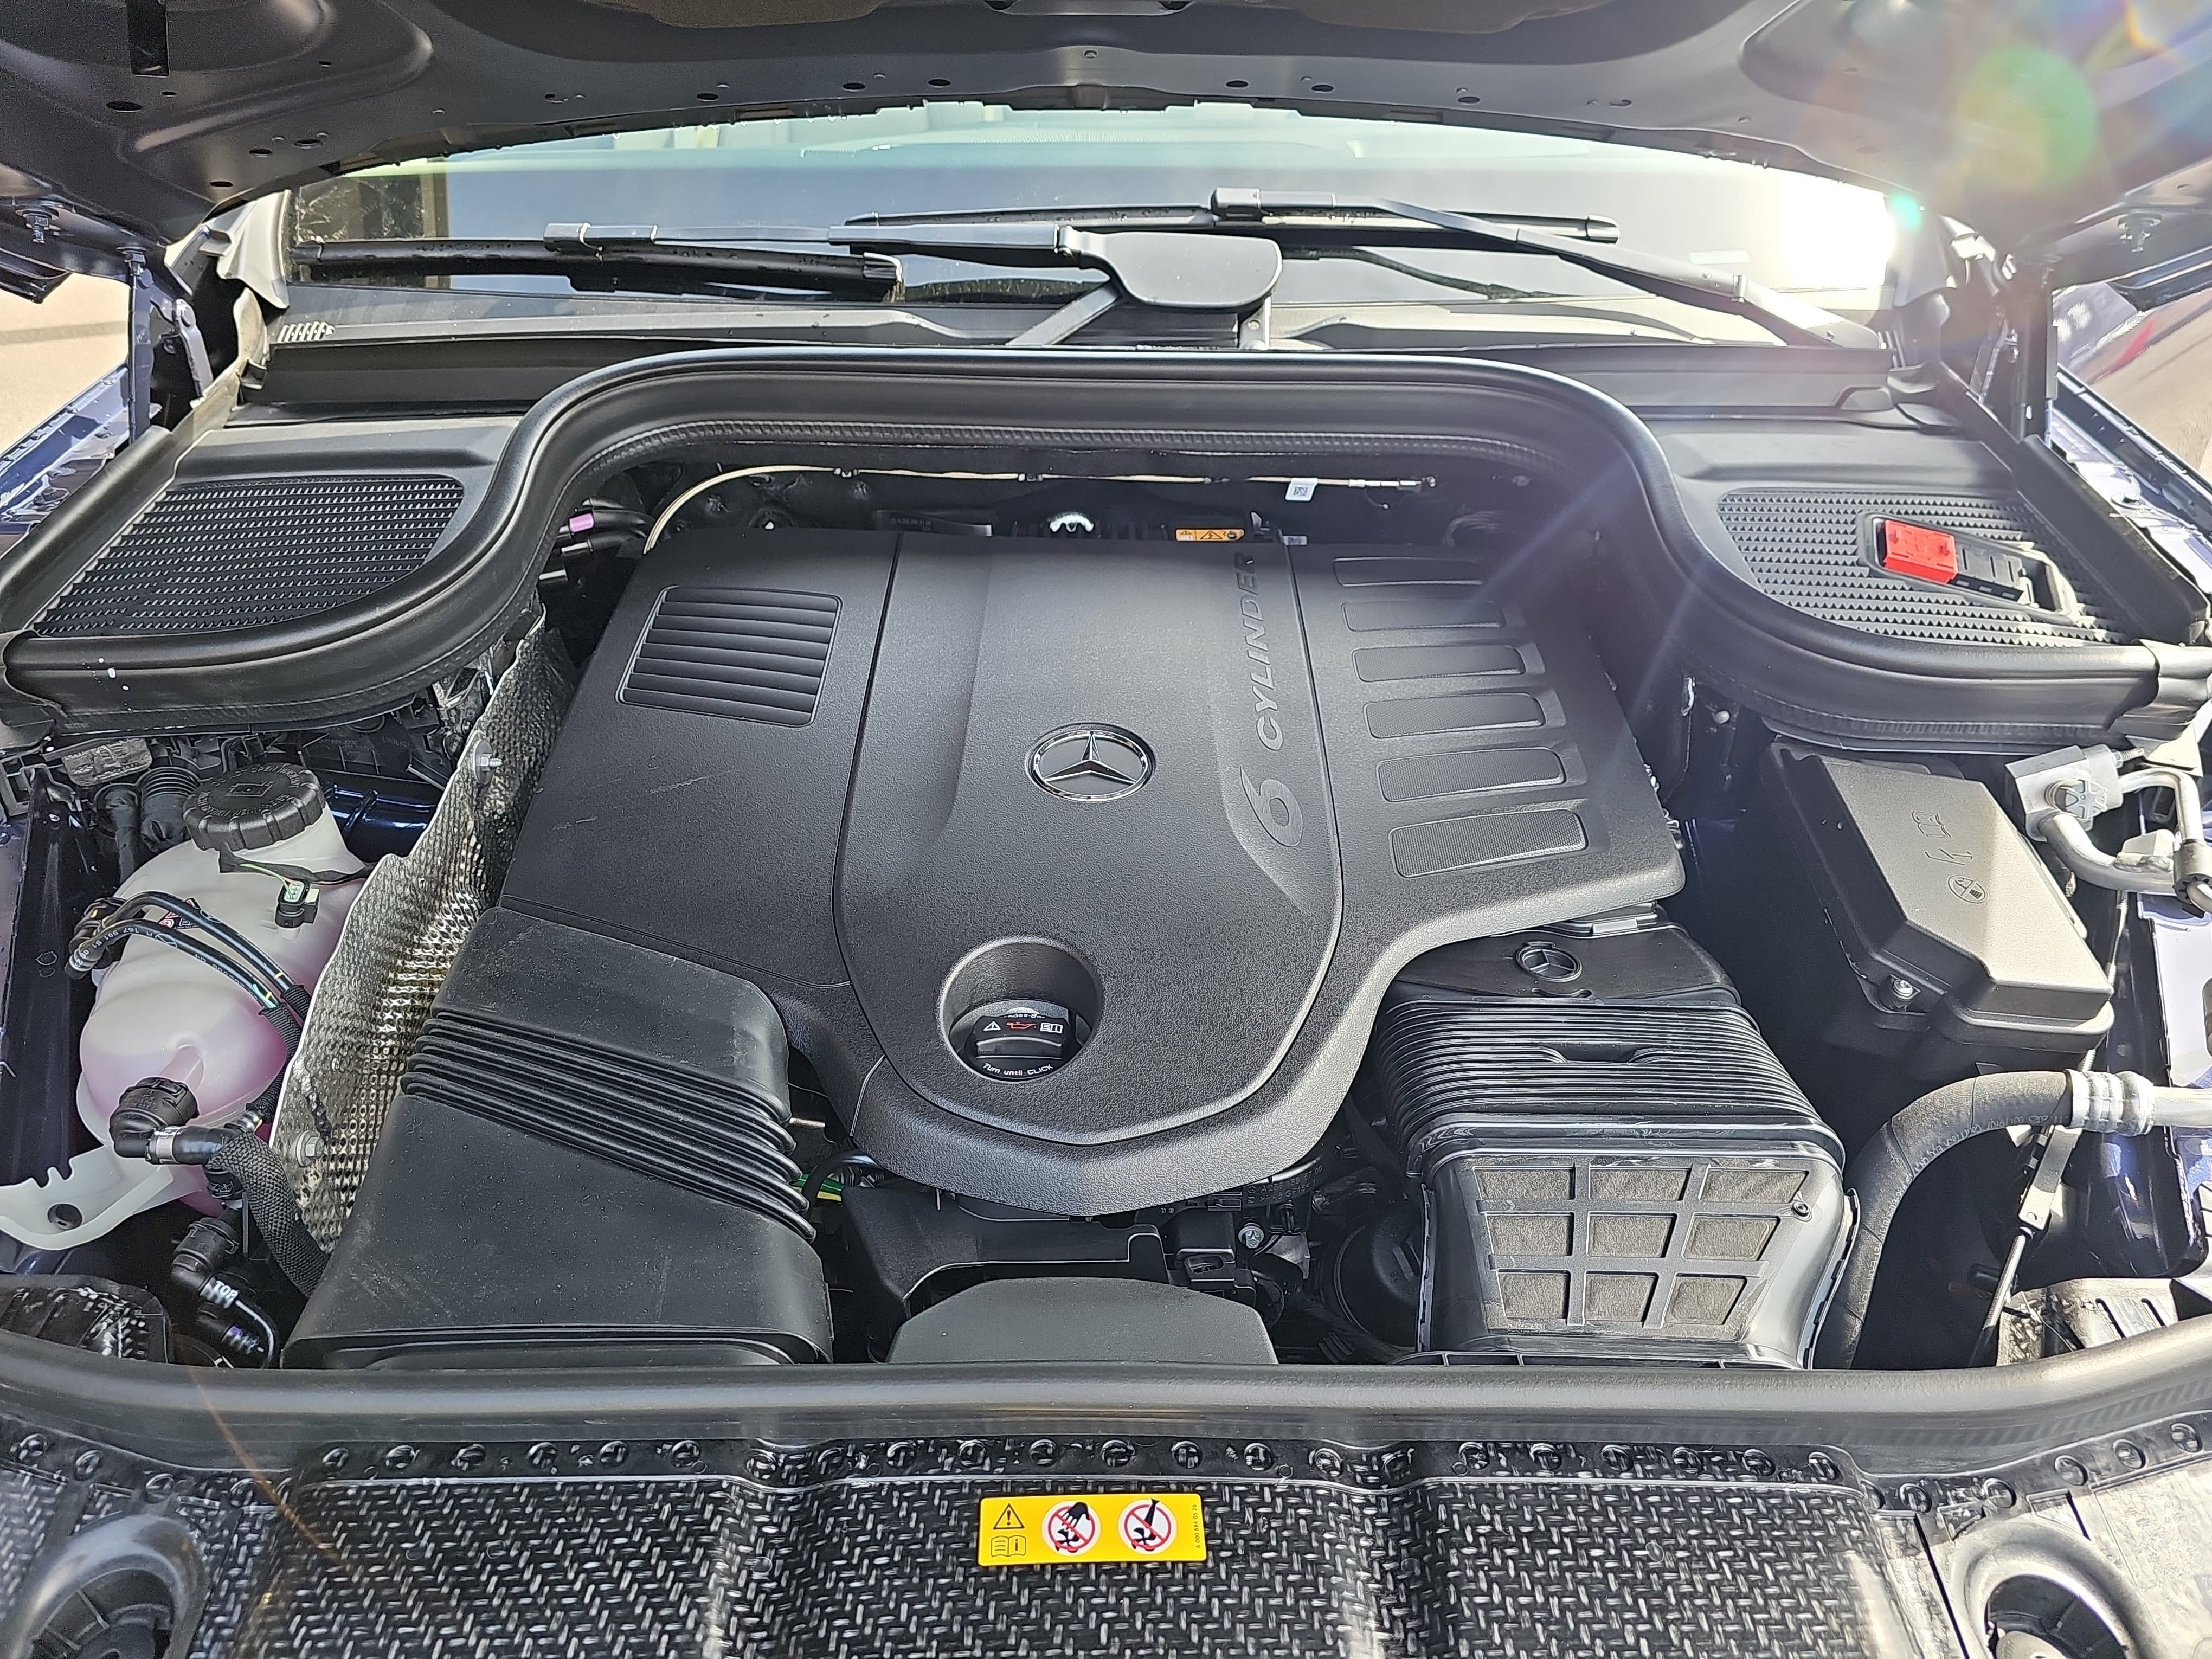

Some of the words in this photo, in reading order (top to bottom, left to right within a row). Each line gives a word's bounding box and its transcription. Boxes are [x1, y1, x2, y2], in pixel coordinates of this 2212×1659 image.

[1234, 552, 1284, 751] CYLINDER
[1240, 766, 1303, 847] 6
[104, 929, 119, 941] 501
[80, 949, 89, 959] 00
[982, 1063, 1001, 1074] Turn
[1027, 1064, 1054, 1075] CLICK
